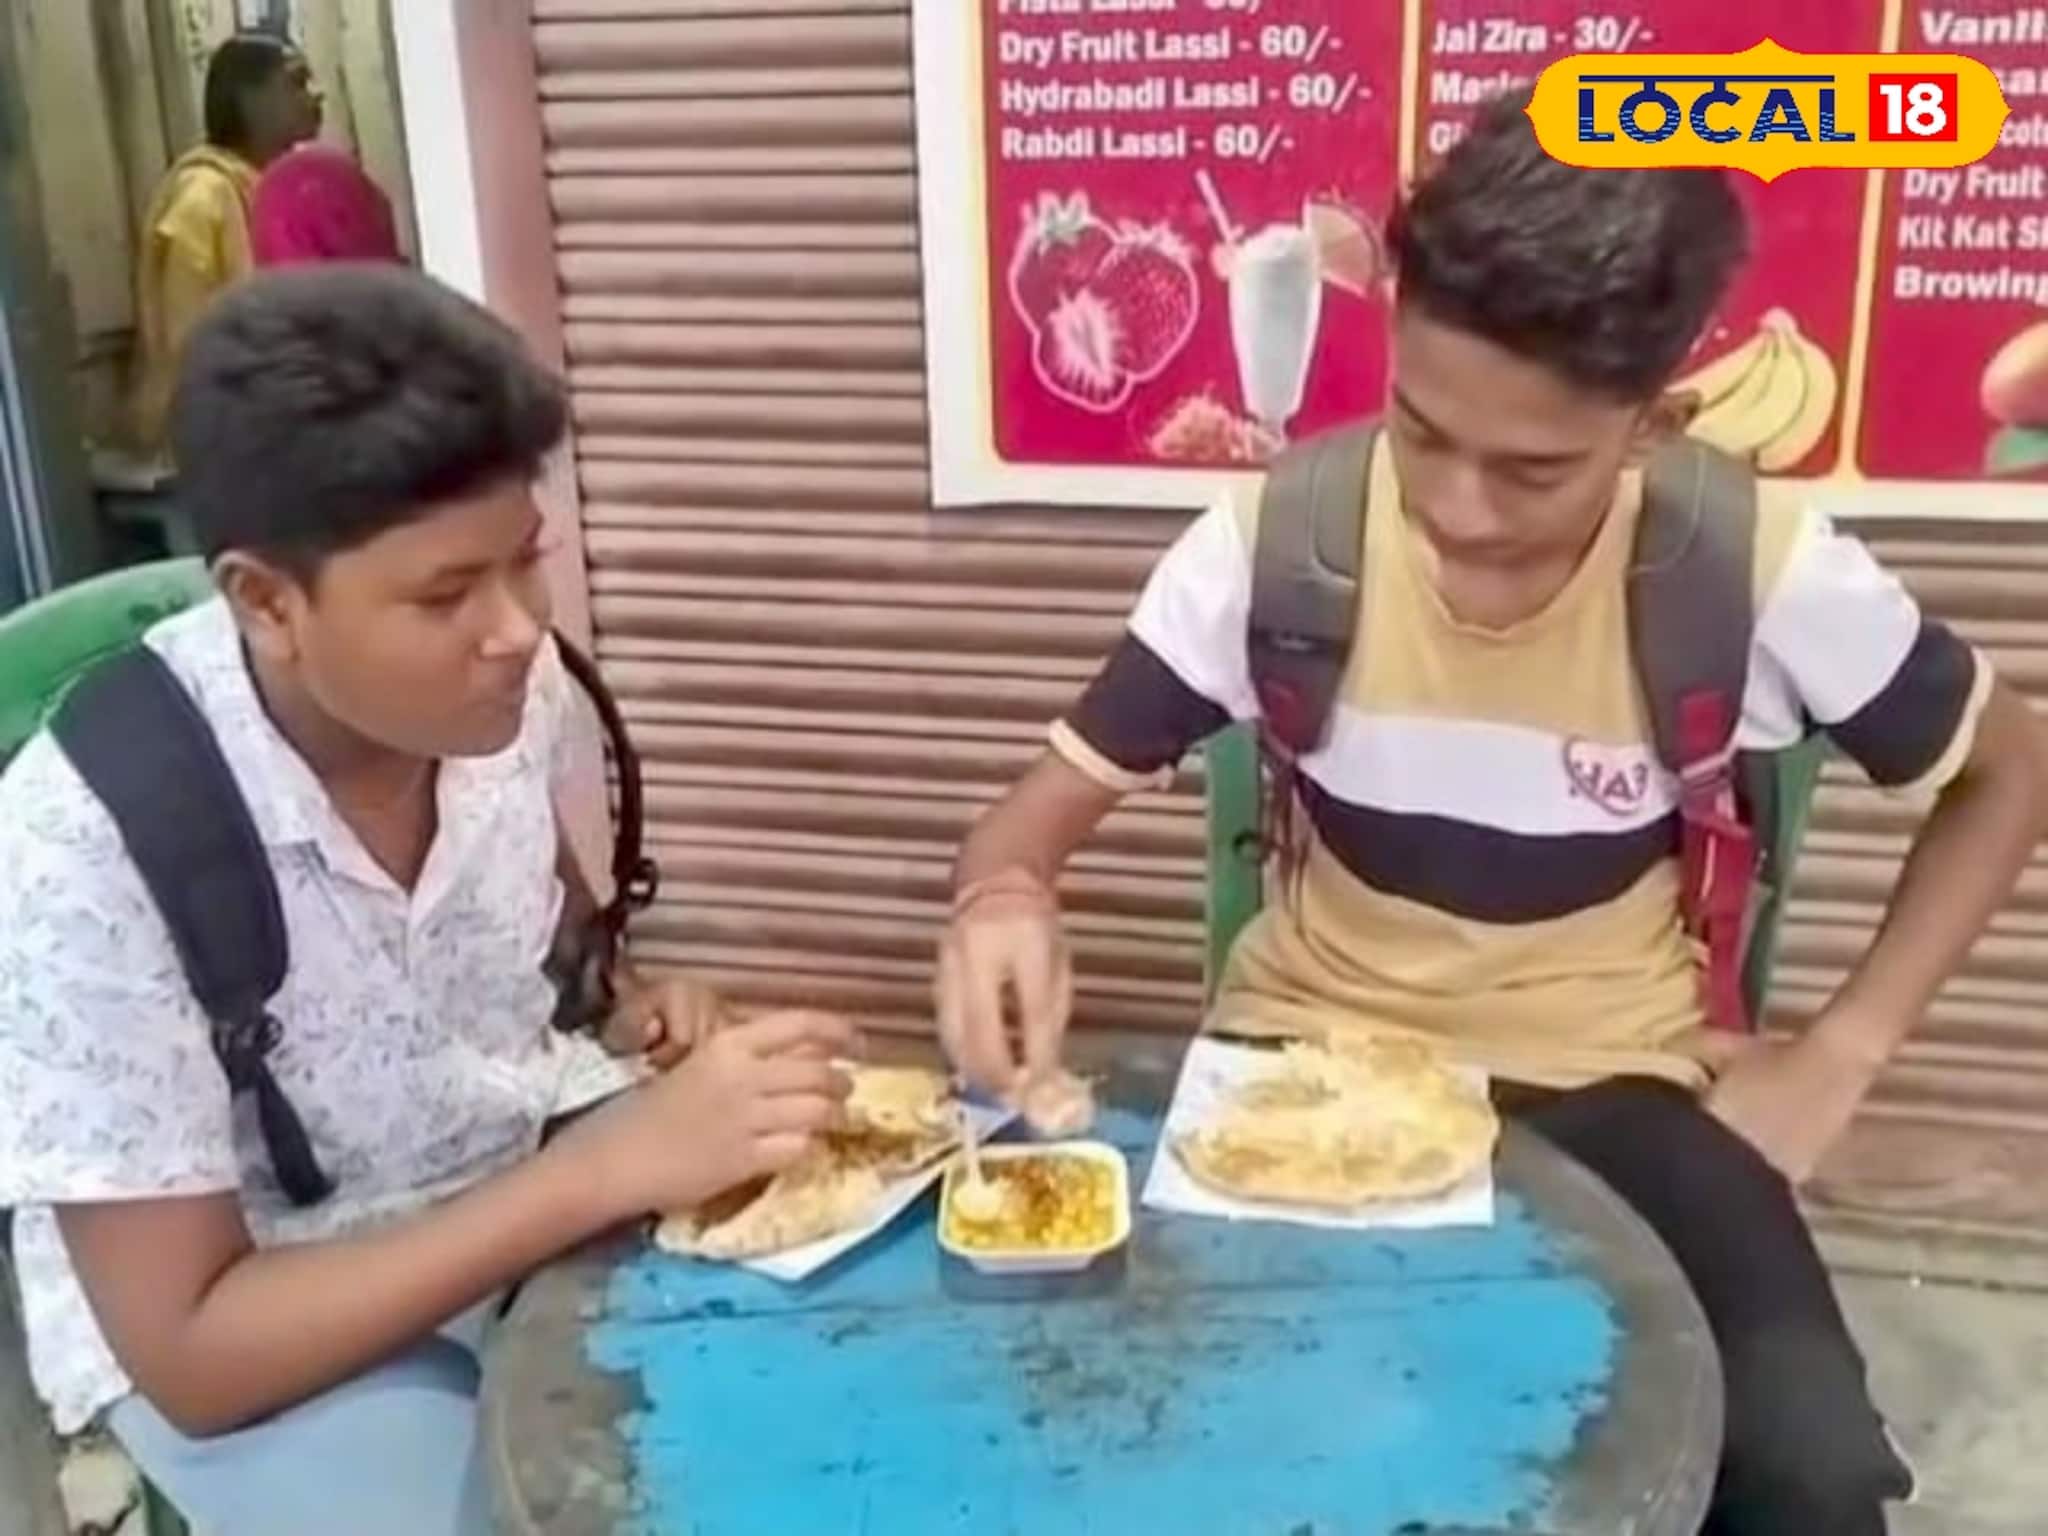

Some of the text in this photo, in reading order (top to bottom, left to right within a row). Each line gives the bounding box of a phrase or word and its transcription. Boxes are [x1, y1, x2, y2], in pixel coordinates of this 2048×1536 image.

[999, 32, 1053, 68] Dry
[1060, 29, 1138, 63] Fruit
[1144, 28, 1231, 61] Lassi
[1259, 24, 1344, 63] 60/-
[1433, 19, 1477, 53] Jal
[1481, 18, 1548, 52] Zira
[1573, 16, 1654, 53] 30/-
[999, 77, 1166, 116] Hydrabadi
[1172, 76, 1260, 110] Lassi
[1287, 73, 1374, 113] 60/-
[1000, 125, 1095, 159] Rabdi
[1101, 124, 1187, 158] Lassi
[1212, 124, 1296, 163] 60/-
[1904, 164, 2046, 206] Dry Fruit
[1898, 213, 1946, 250] Kit
[1951, 213, 2011, 250] Kat
